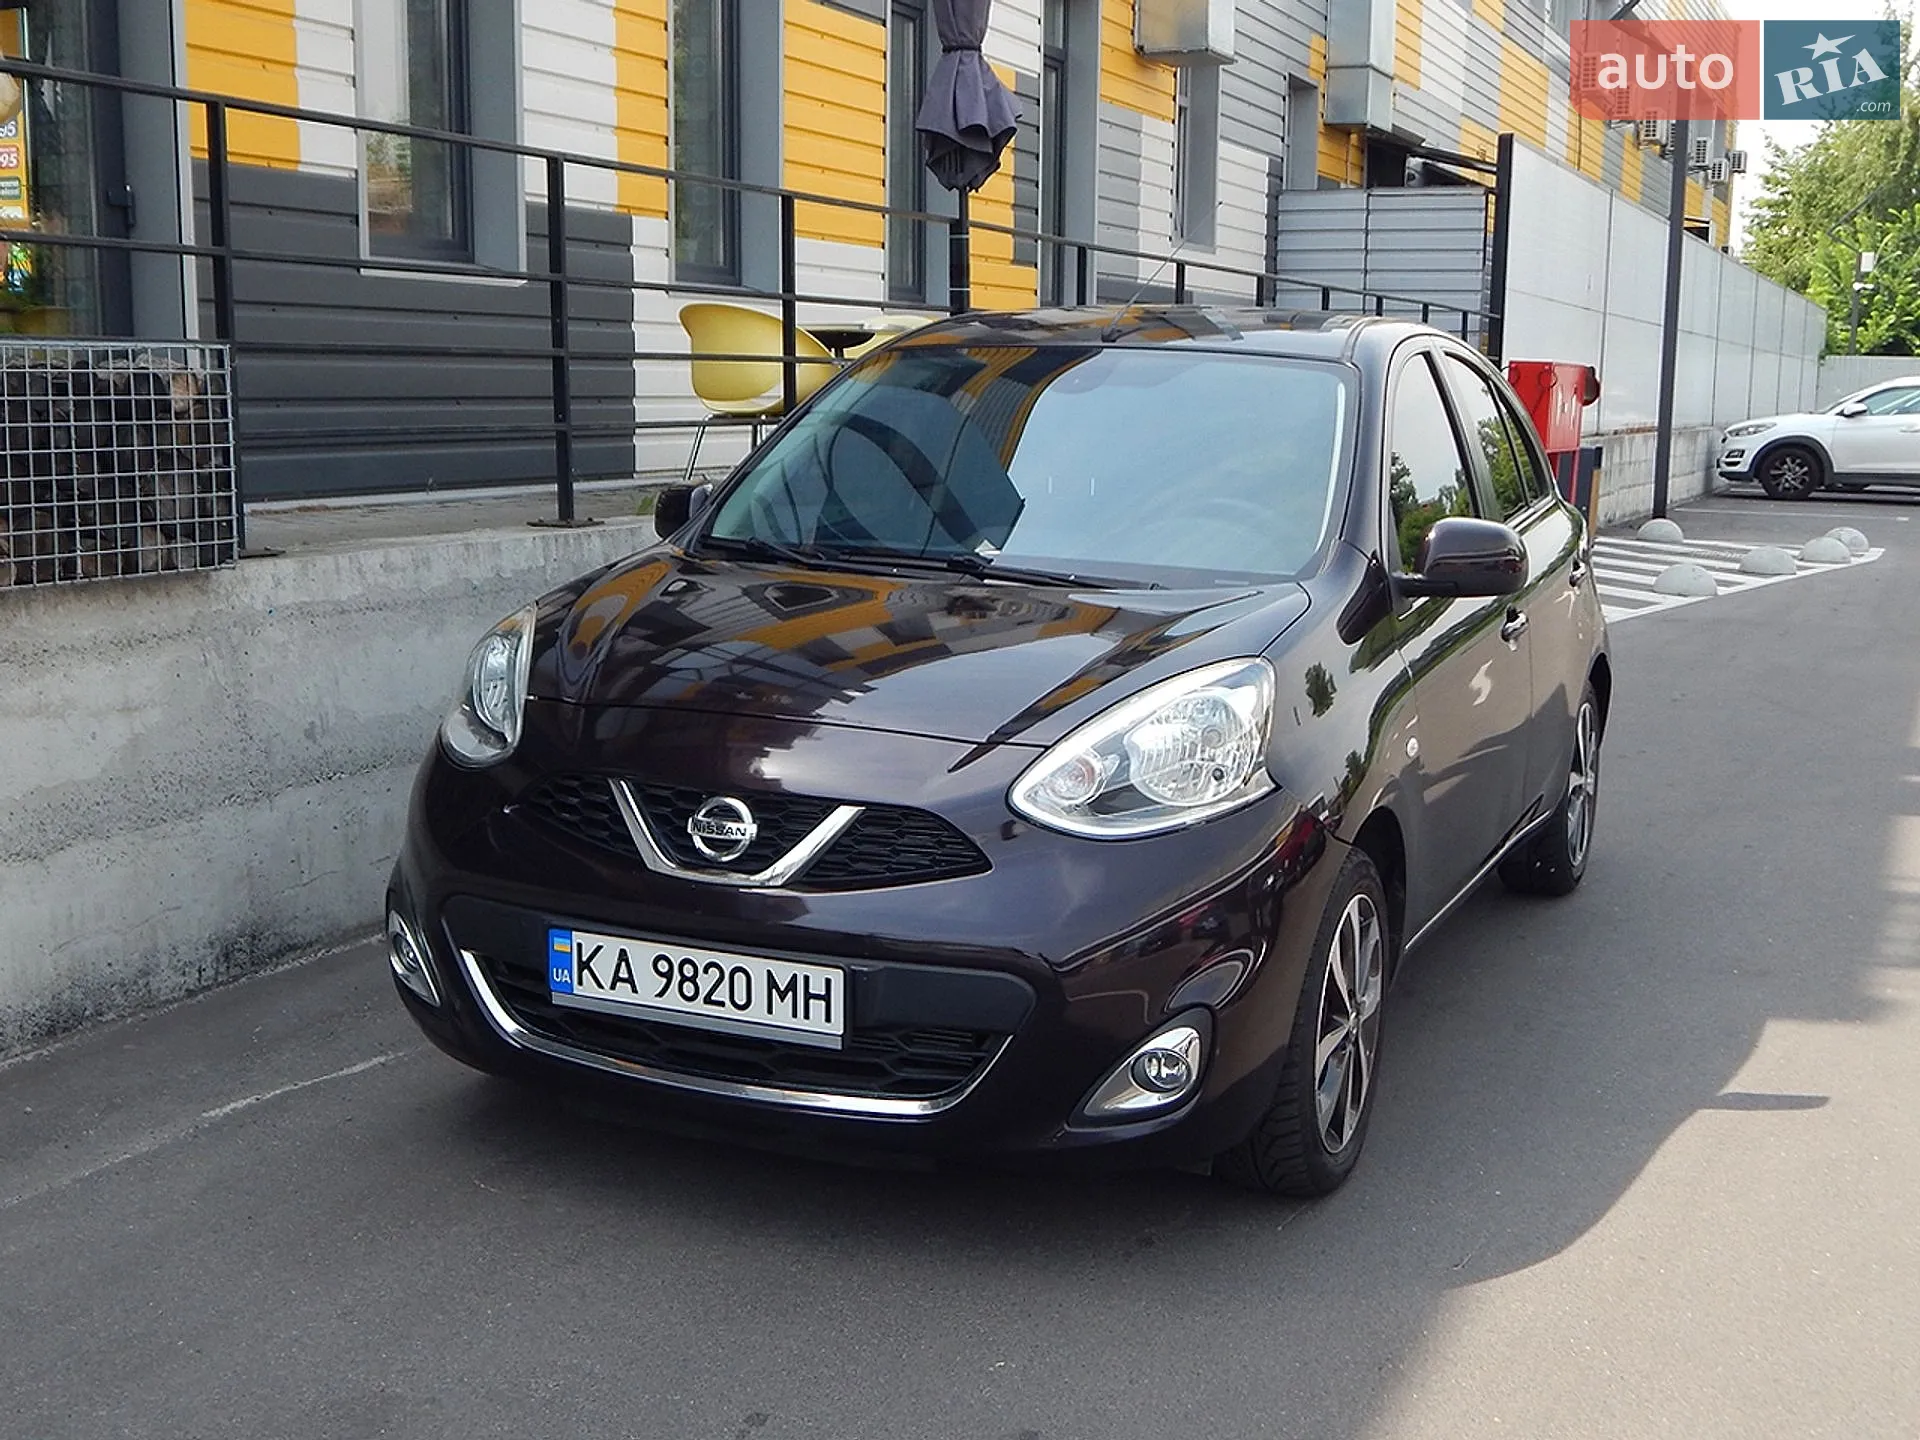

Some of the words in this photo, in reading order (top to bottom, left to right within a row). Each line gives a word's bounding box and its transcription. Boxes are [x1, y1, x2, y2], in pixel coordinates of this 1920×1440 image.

[692, 821, 747, 837] NISSAN
[553, 968, 571, 983] UA
[575, 942, 639, 995] KA
[651, 953, 754, 1012] 9820
[766, 968, 833, 1024] MH
